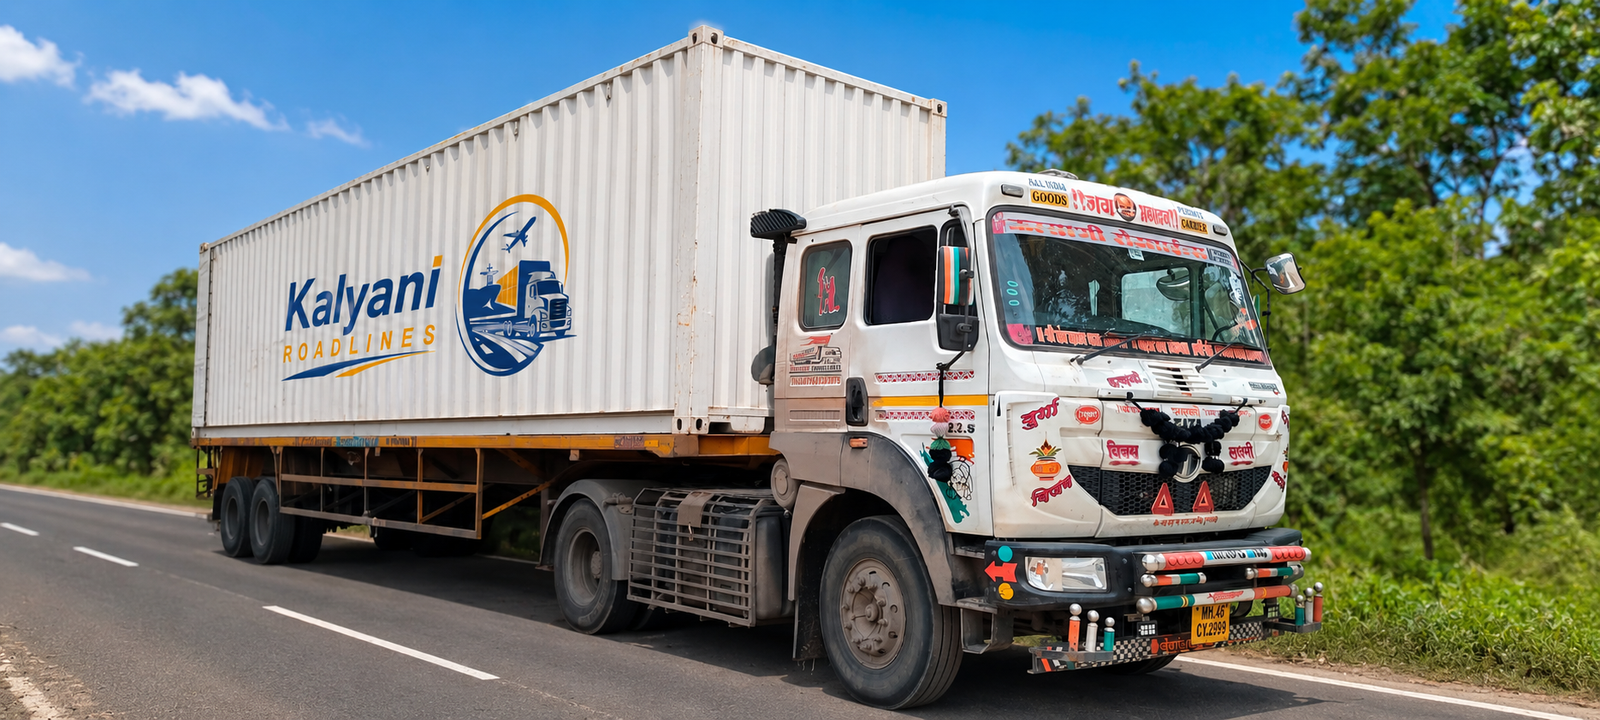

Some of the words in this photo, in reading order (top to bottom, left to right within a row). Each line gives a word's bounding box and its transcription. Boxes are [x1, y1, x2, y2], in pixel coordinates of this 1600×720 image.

[1032, 190, 1068, 206] GOODS
[285, 255, 443, 336] Kalyani
[283, 324, 436, 363] ROADLINES
